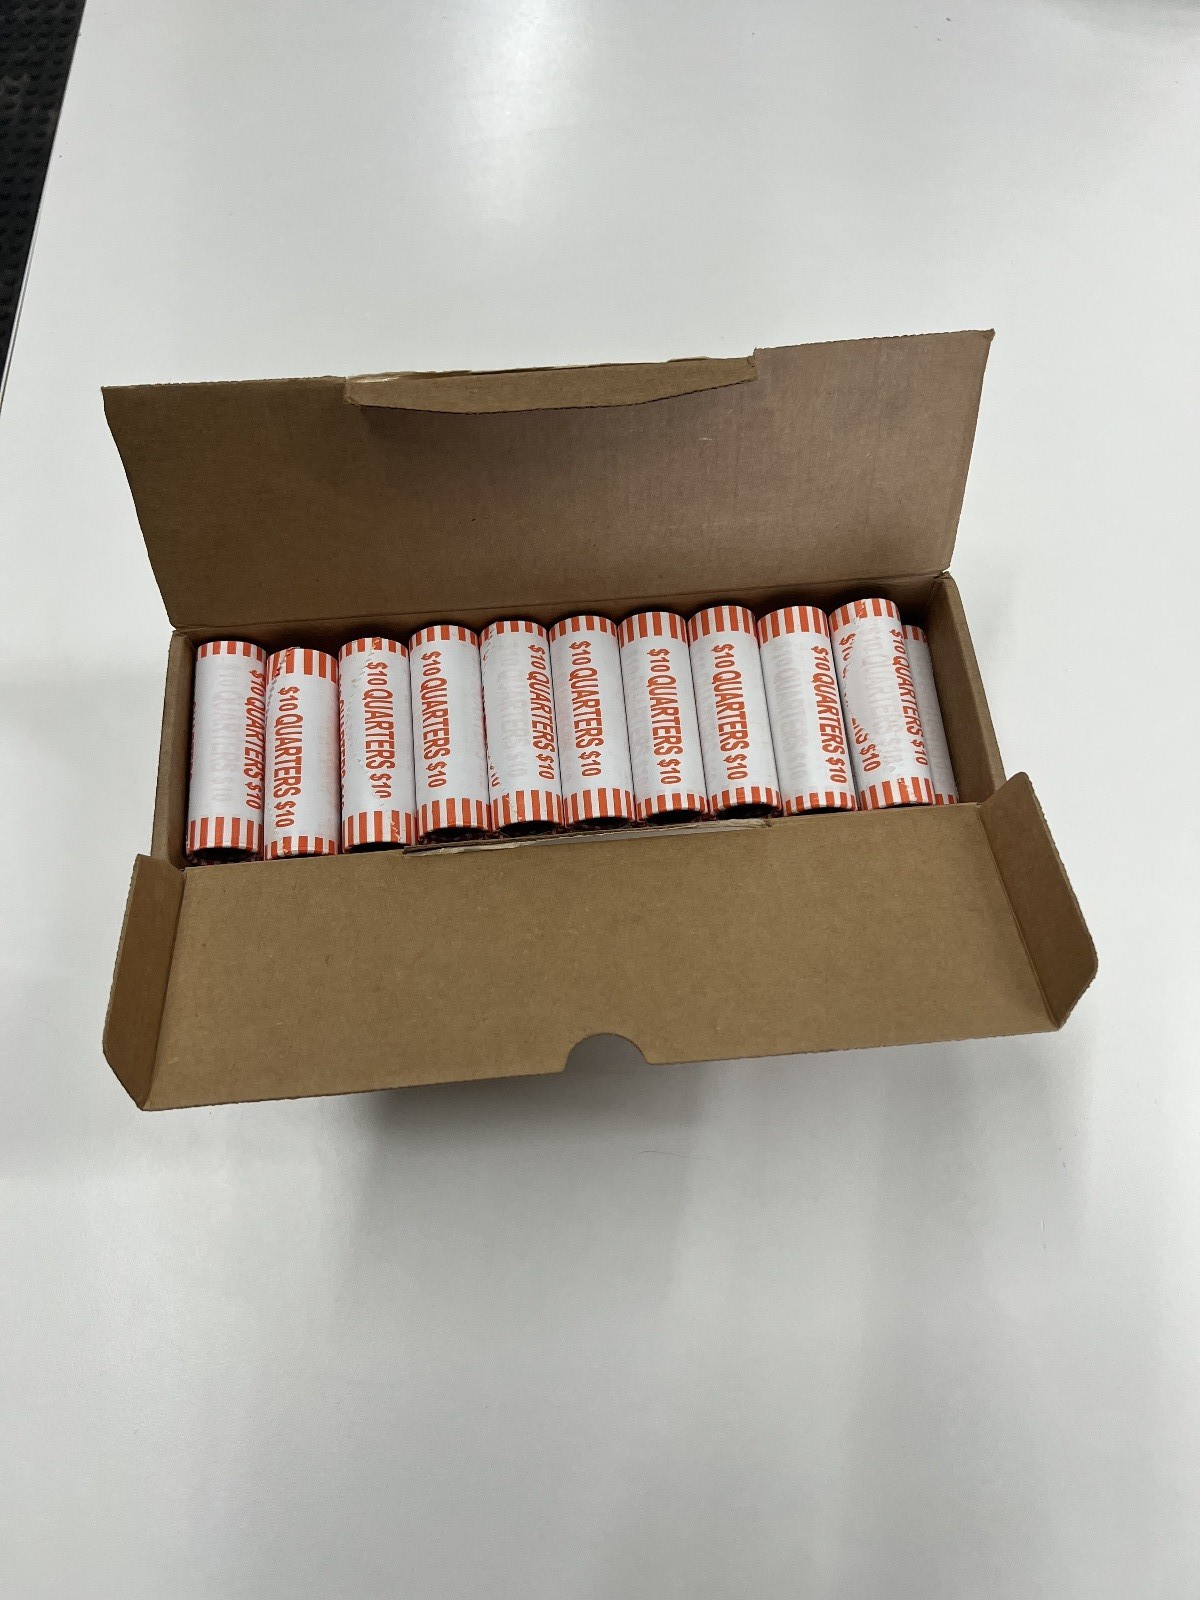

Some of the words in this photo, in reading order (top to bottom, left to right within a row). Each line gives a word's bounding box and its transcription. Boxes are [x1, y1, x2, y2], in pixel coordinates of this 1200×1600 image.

[569, 641, 591, 665] $10
[889, 629, 907, 654] $10
[421, 651, 442, 676] $10
[528, 645, 546, 670] $10
[647, 648, 670, 672] $10
[711, 643, 735, 669] $10
[811, 646, 830, 671] $10
[249, 669, 266, 696] $10
[366, 662, 388, 686] $10
[278, 686, 300, 712] $10
[569, 667, 604, 748] QUARTERS
[892, 655, 923, 738] QUARTERS
[420, 678, 451, 760] QUARTERS
[527, 671, 555, 752] QUARTERS
[647, 675, 684, 756] QUARTERS
[711, 670, 750, 752] QUARTERS
[812, 673, 846, 755] QUARTERS
[244, 697, 266, 783] QUARTERS
[363, 688, 396, 770] QUARTERS
[273, 713, 303, 799] QUARTERS
[578, 751, 601, 777] $10
[859, 744, 881, 772] $10
[911, 739, 928, 766] $10
[426, 761, 447, 788] $10
[536, 754, 555, 780] $10
[657, 759, 681, 784] $10
[723, 754, 748, 780] $10
[825, 757, 847, 784] $10
[246, 781, 264, 810] $10
[274, 801, 296, 828] $10
